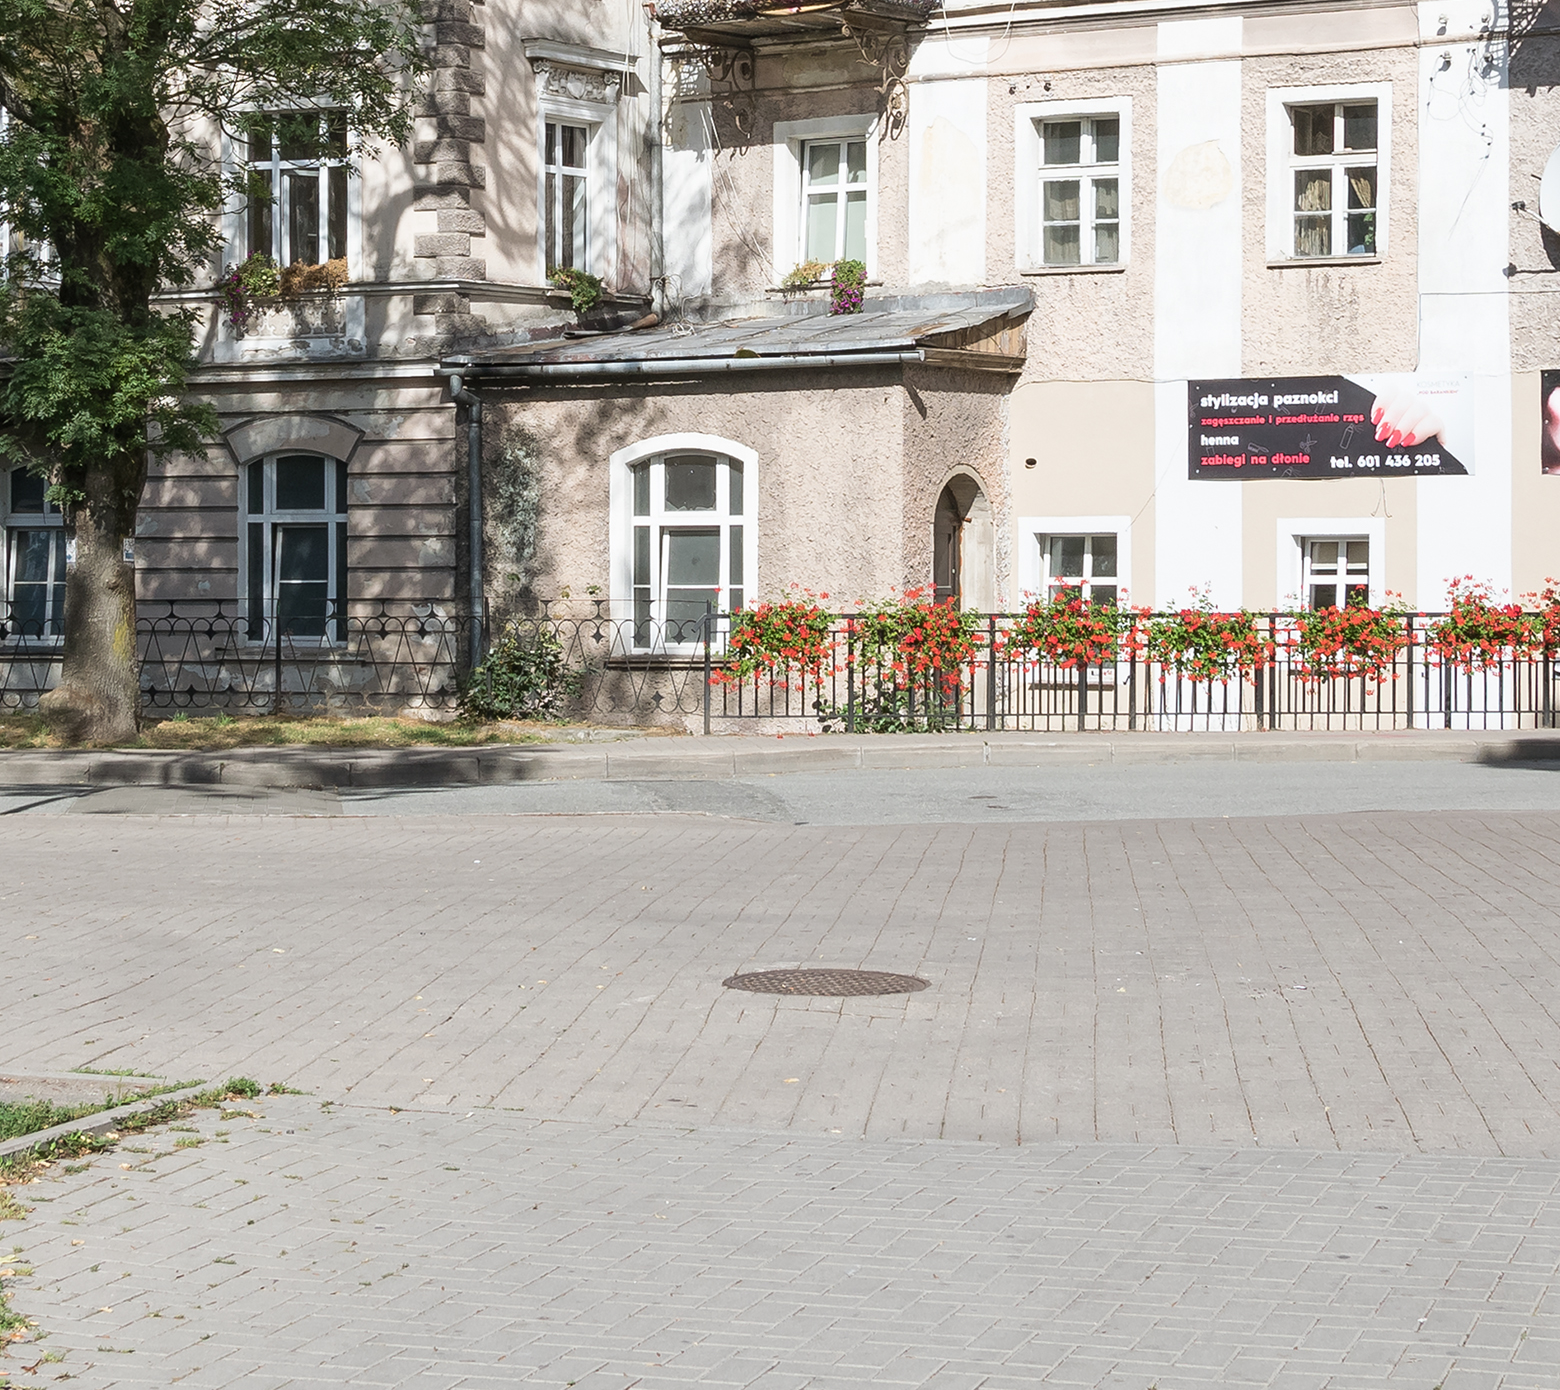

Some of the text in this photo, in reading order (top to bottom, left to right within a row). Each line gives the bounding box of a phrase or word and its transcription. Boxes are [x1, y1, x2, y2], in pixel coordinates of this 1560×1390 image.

[1200, 390, 1339, 409] stylizacja paznokci
[1201, 413, 1365, 427] zagęszczanie i przedłużanie rzęs
[1200, 434, 1239, 446] henna
[1201, 452, 1310, 468] zabiegi na dłonie
[1330, 454, 1440, 468] tel. 601 436 205
